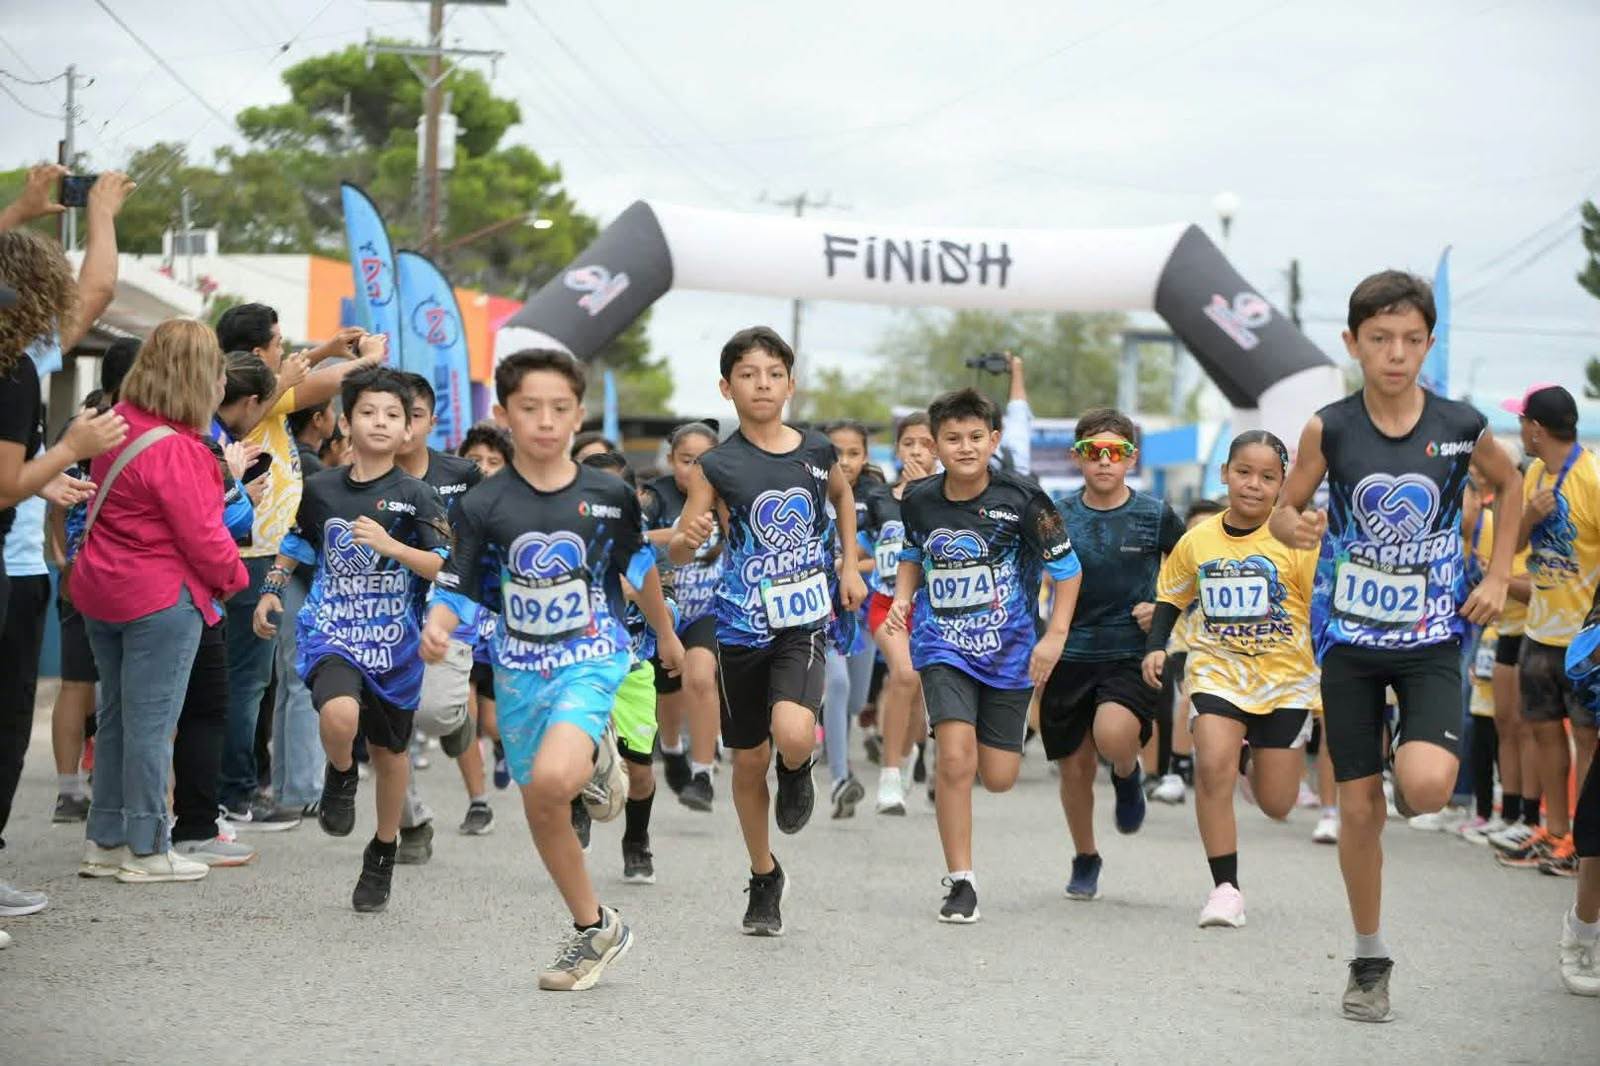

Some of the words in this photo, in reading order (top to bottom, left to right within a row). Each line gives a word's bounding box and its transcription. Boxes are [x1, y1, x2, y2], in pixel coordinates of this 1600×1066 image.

[440, 483, 467, 495] SIMAS
[933, 574, 990, 599] 0974
[1206, 586, 1263, 609] 1017
[1346, 574, 1419, 612] 1002
[511, 592, 584, 623] 0962
[773, 583, 826, 619] 1001
